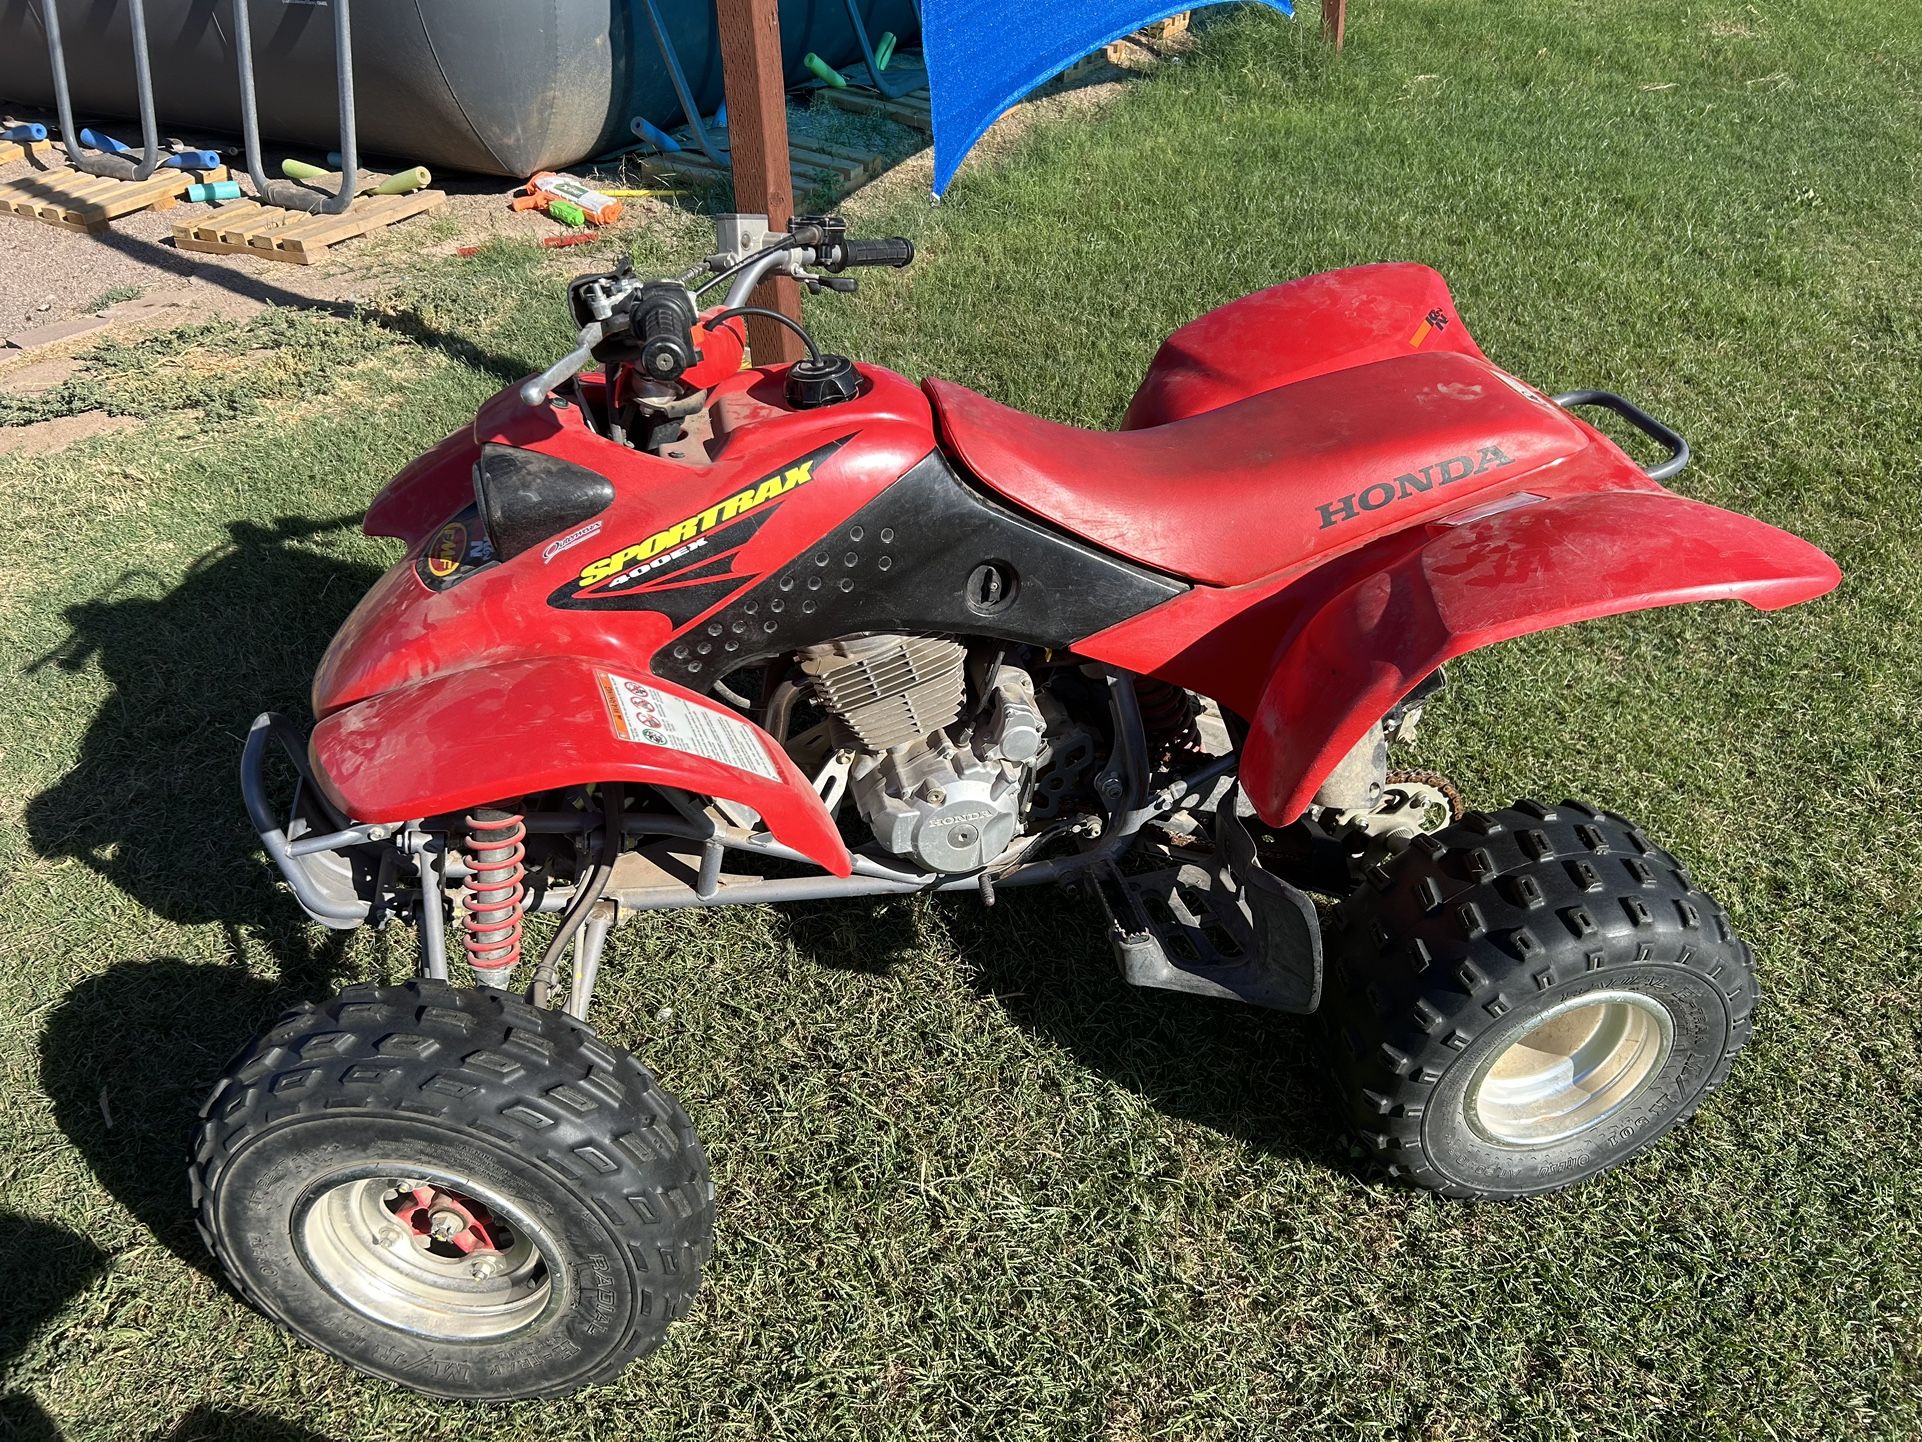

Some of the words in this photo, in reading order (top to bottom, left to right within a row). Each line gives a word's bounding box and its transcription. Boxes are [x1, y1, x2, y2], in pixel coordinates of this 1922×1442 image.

[578, 460, 813, 587] SPORTRAX
[1315, 445, 1515, 529] HONDA
[609, 537, 708, 587] 400EX
[928, 809, 994, 828] HONDA
[587, 1254, 615, 1335] RADIAL
